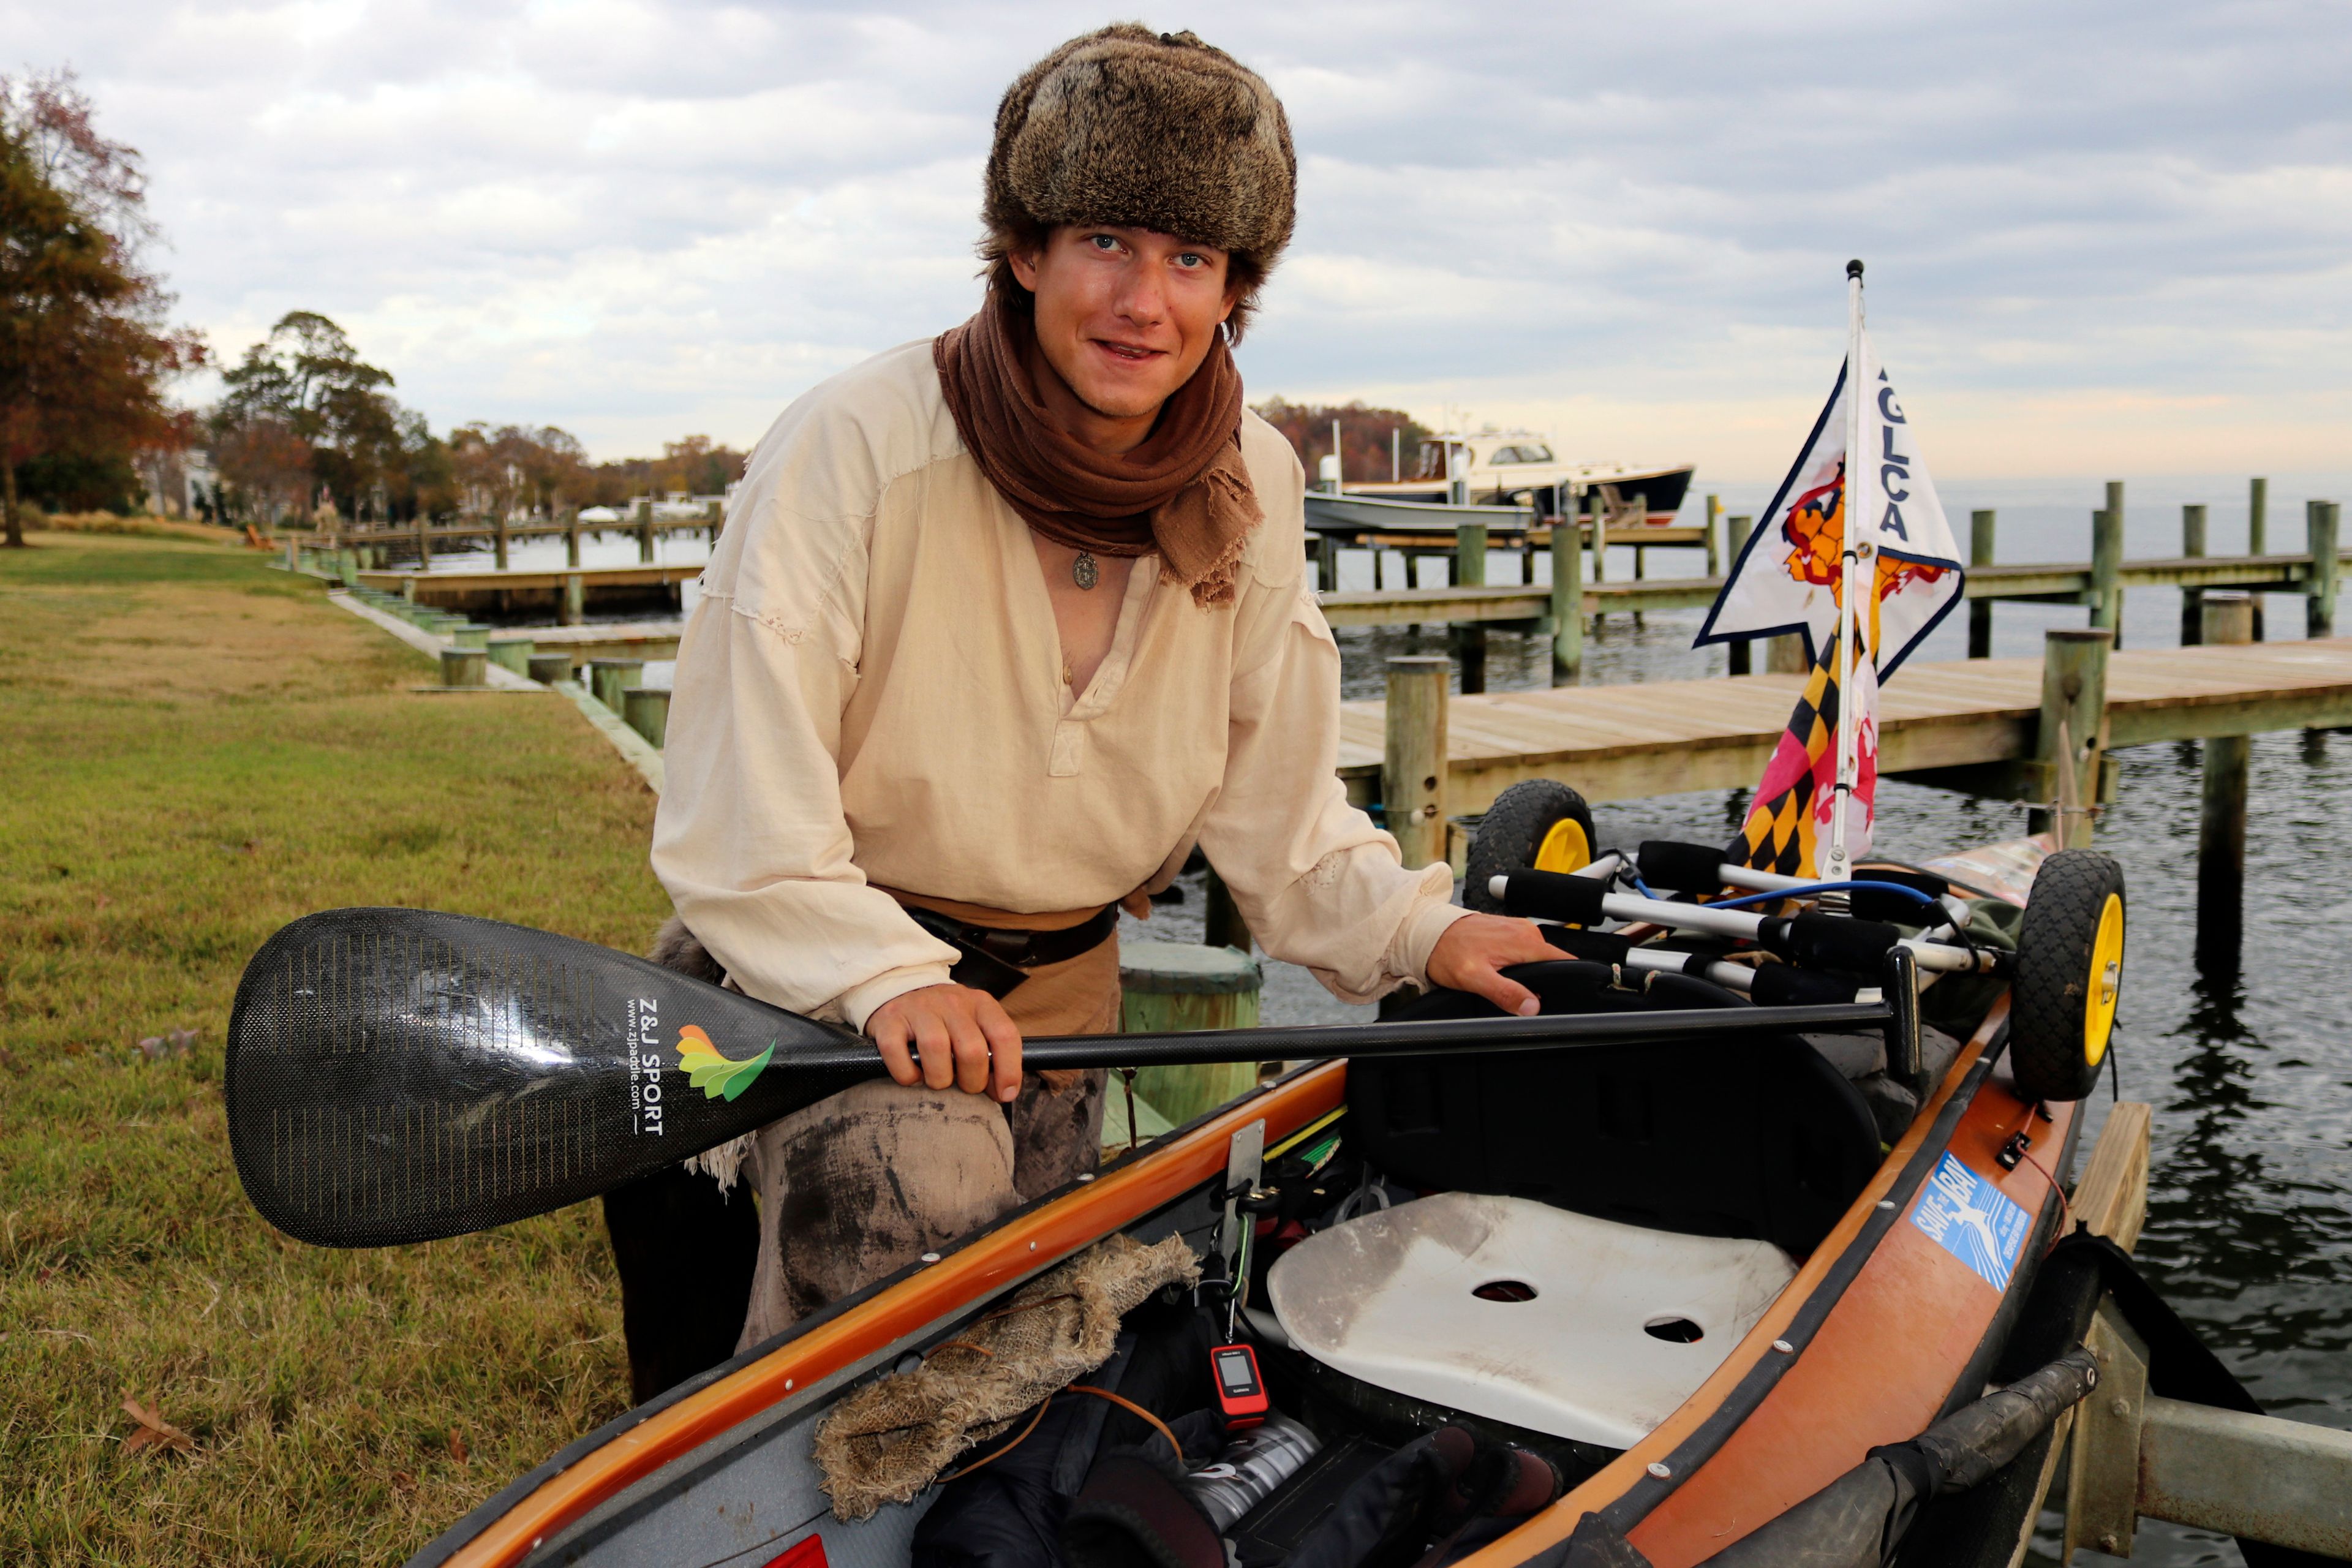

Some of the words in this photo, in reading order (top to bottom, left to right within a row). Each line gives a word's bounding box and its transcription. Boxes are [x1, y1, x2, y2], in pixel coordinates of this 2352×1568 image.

[1878, 368, 1910, 541] GLCA
[627, 999, 640, 1110] www.zjpaddle.com
[639, 998, 659, 1045] Z&J
[642, 1054, 663, 1136] SPORT
[1916, 1194, 1951, 1242] SAVE
[1939, 1153, 1978, 1203] BAY
